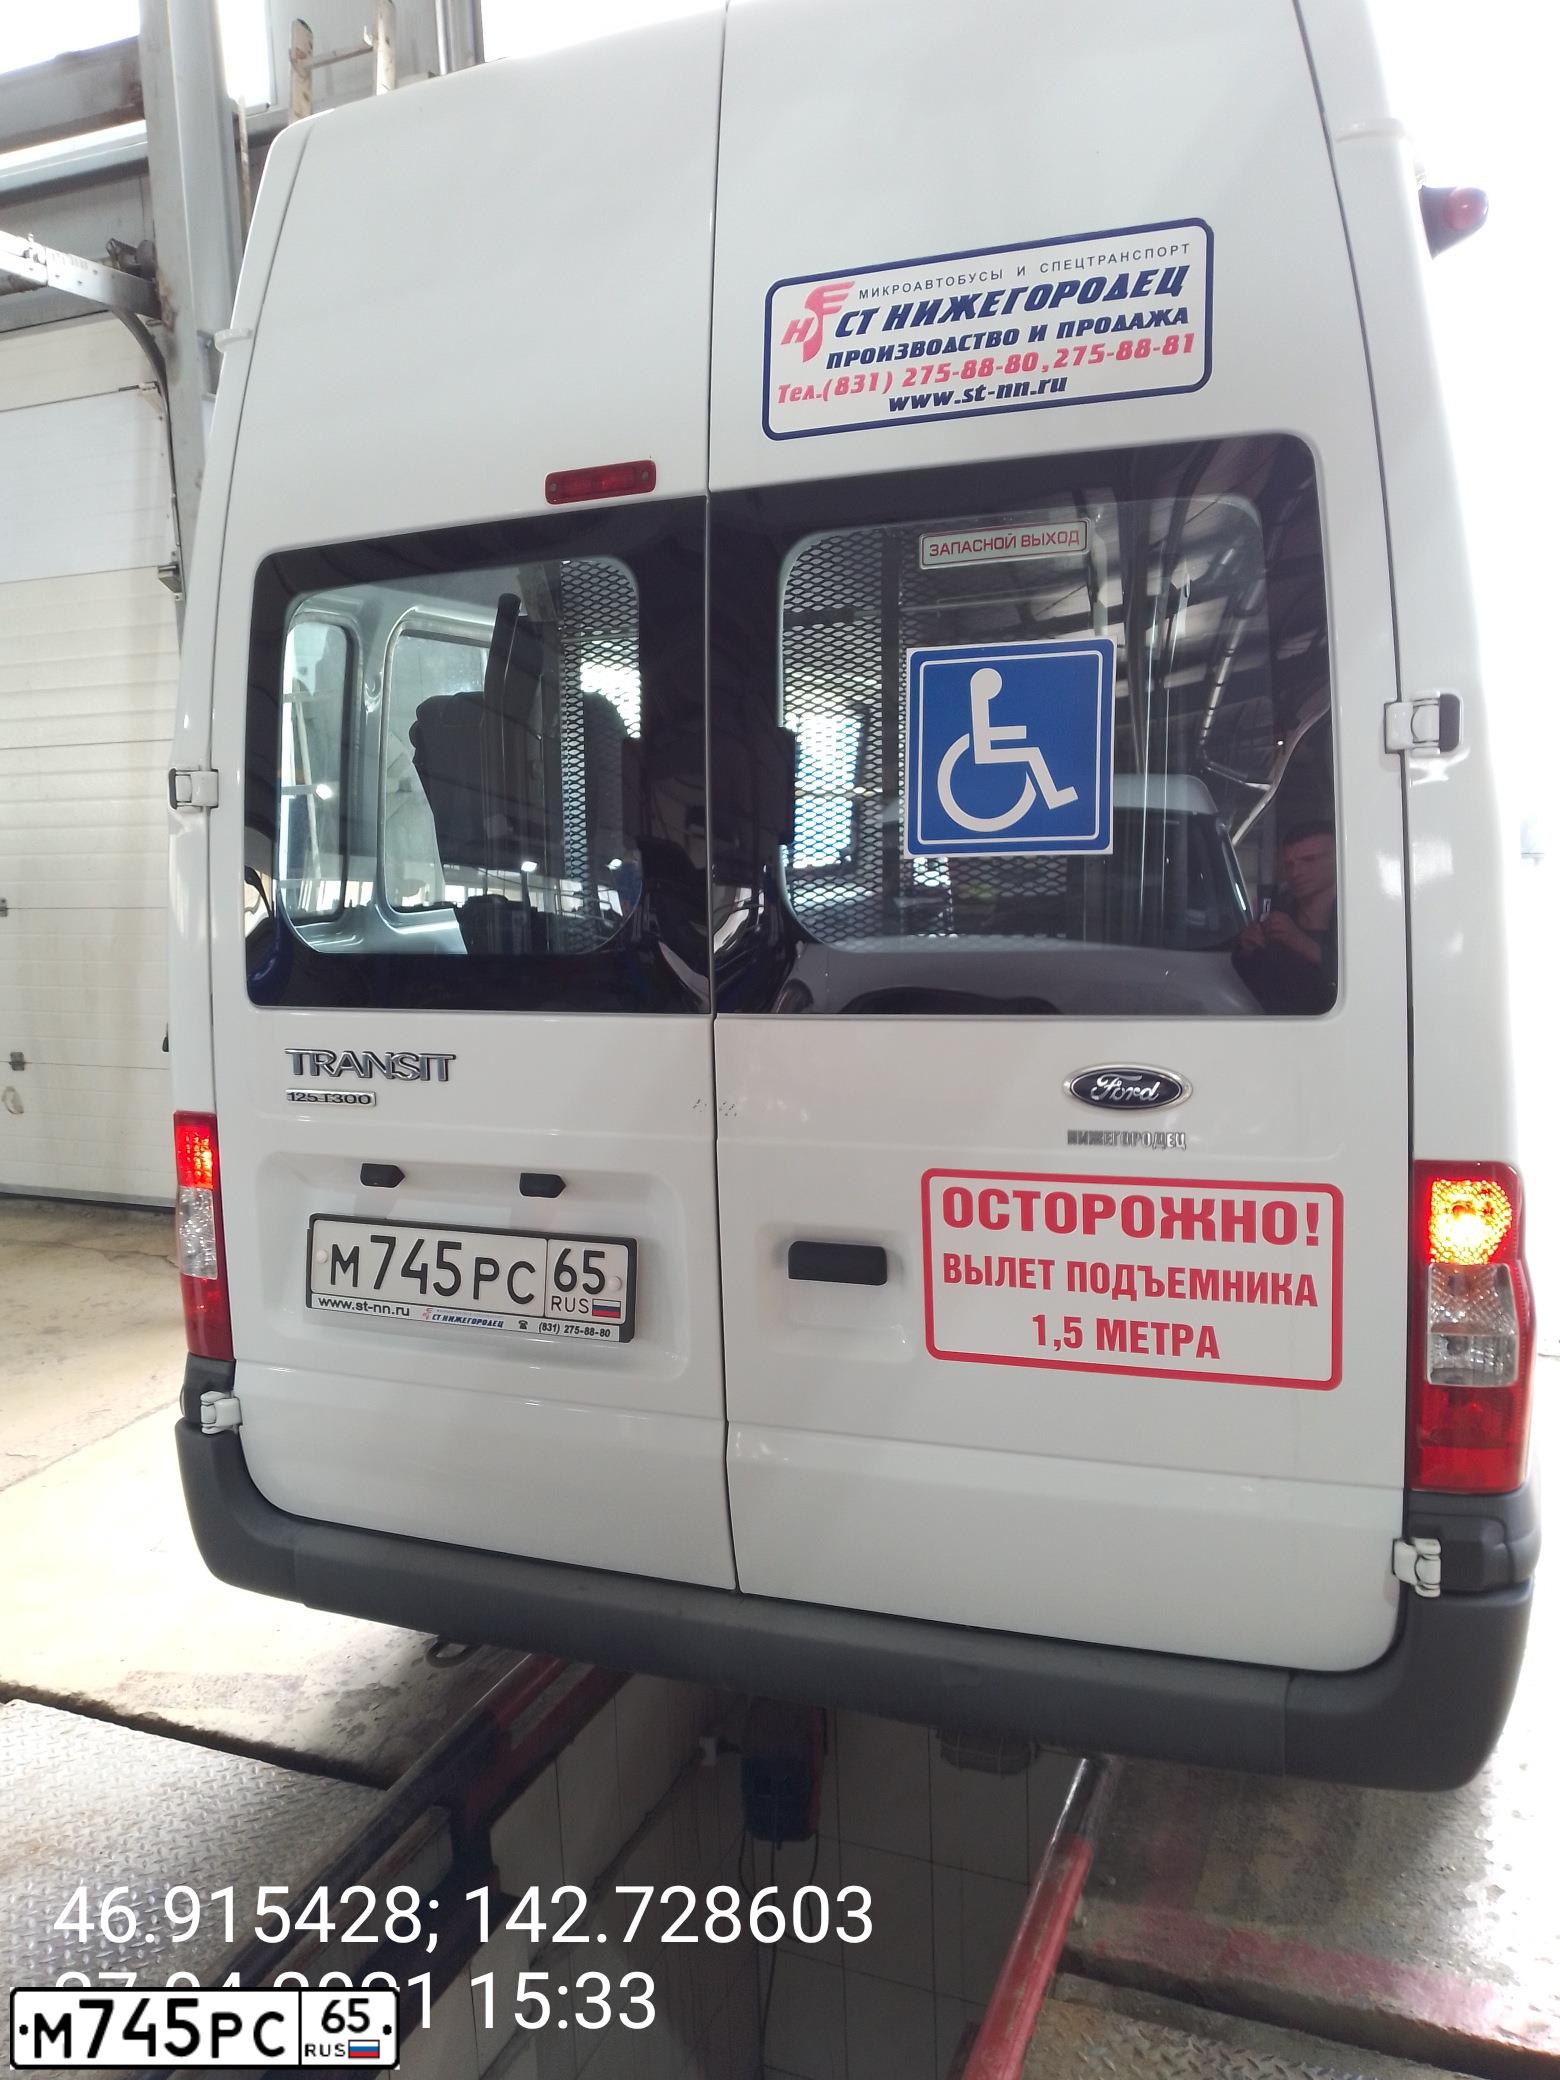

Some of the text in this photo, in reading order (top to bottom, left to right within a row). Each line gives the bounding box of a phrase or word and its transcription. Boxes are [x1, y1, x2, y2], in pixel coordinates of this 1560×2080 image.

[858, 243, 1191, 300] МИКРОАВТОБУСЫ И СПЕЦТРАНСПОРТ
[834, 264, 1190, 338] СТ НИЖЕГОРОДЕЦ
[825, 306, 1189, 370] ПРОИЗВОДСТВО И ПРОДАЖА
[889, 376, 1068, 412] www.st-nn.ru
[929, 530, 1080, 557] ЗАПАСНОЙ ВЫХОД
[285, 1048, 456, 1082] TRANSIT
[1090, 1073, 1161, 1101] Ford
[1067, 1129, 1187, 1150] НИЖЕГОРОДЕЦ
[942, 1186, 1319, 1247] ОСТОРОЖНО!
[553, 1248, 606, 1295] 65
[943, 1253, 1318, 1307] ВЫЛЕТ ПОДЪЕМНИКА
[318, 1297, 410, 1317] www.st-nn.ru
[551, 1295, 589, 1314] RUS
[538, 1322, 611, 1337] (831) 275-88-80
[1032, 1314, 1220, 1359] 1,5 МЕТРА
